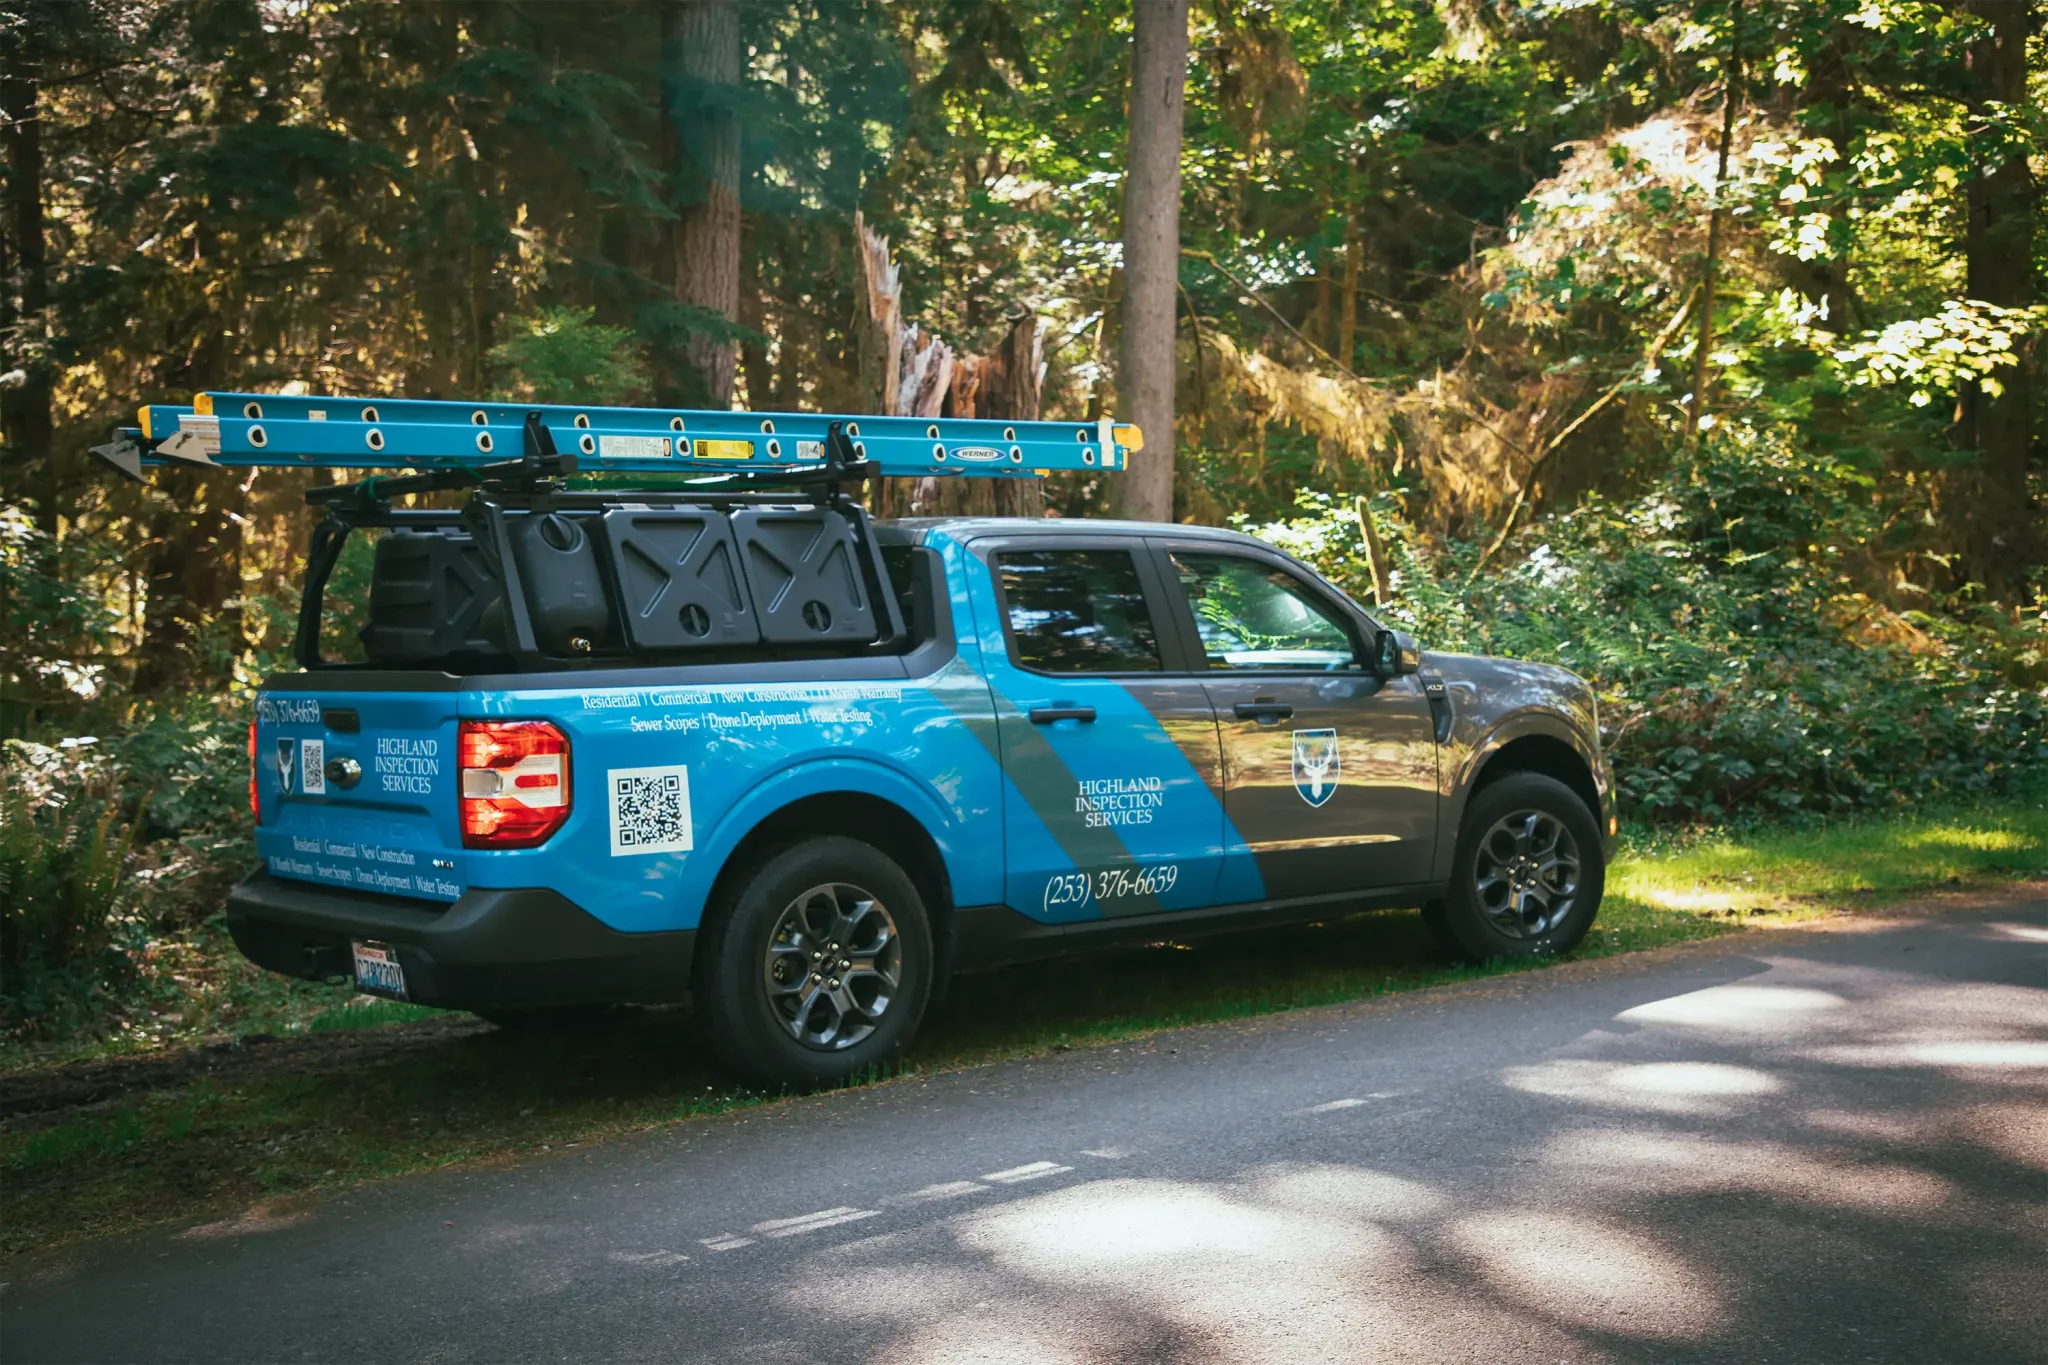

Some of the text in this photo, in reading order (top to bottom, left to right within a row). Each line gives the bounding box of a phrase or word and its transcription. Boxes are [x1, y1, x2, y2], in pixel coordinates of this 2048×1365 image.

[961, 449, 995, 458] WERNER
[582, 691, 641, 710] Residential
[651, 689, 712, 706] Commercial
[721, 691, 745, 704] New
[746, 688, 808, 703] Construction
[830, 687, 860, 700] Month
[860, 686, 902, 703] Warranty
[277, 699, 320, 723] 376-6659
[630, 715, 663, 732] Sewer
[664, 714, 700, 735] Scopes
[708, 712, 740, 728] Drone
[741, 710, 802, 731] Deployment
[808, 708, 838, 723] Water
[838, 708, 873, 727] Testing
[377, 738, 438, 757] HIGHLAND
[375, 756, 439, 775] INSPECTION
[382, 775, 431, 794] SERVICES
[1078, 776, 1161, 796] HIGHLAND
[1075, 792, 1163, 813] INSPECTION
[1085, 809, 1153, 828] SERVICES
[324, 839, 357, 857] Commercial
[361, 844, 376, 860] New
[376, 845, 415, 866] Construction
[356, 867, 375, 885] Drone
[374, 870, 412, 892] Deployment
[415, 875, 436, 893] Water
[436, 878, 461, 900] Testing
[1043, 865, 1178, 912] (253) 376-6659
